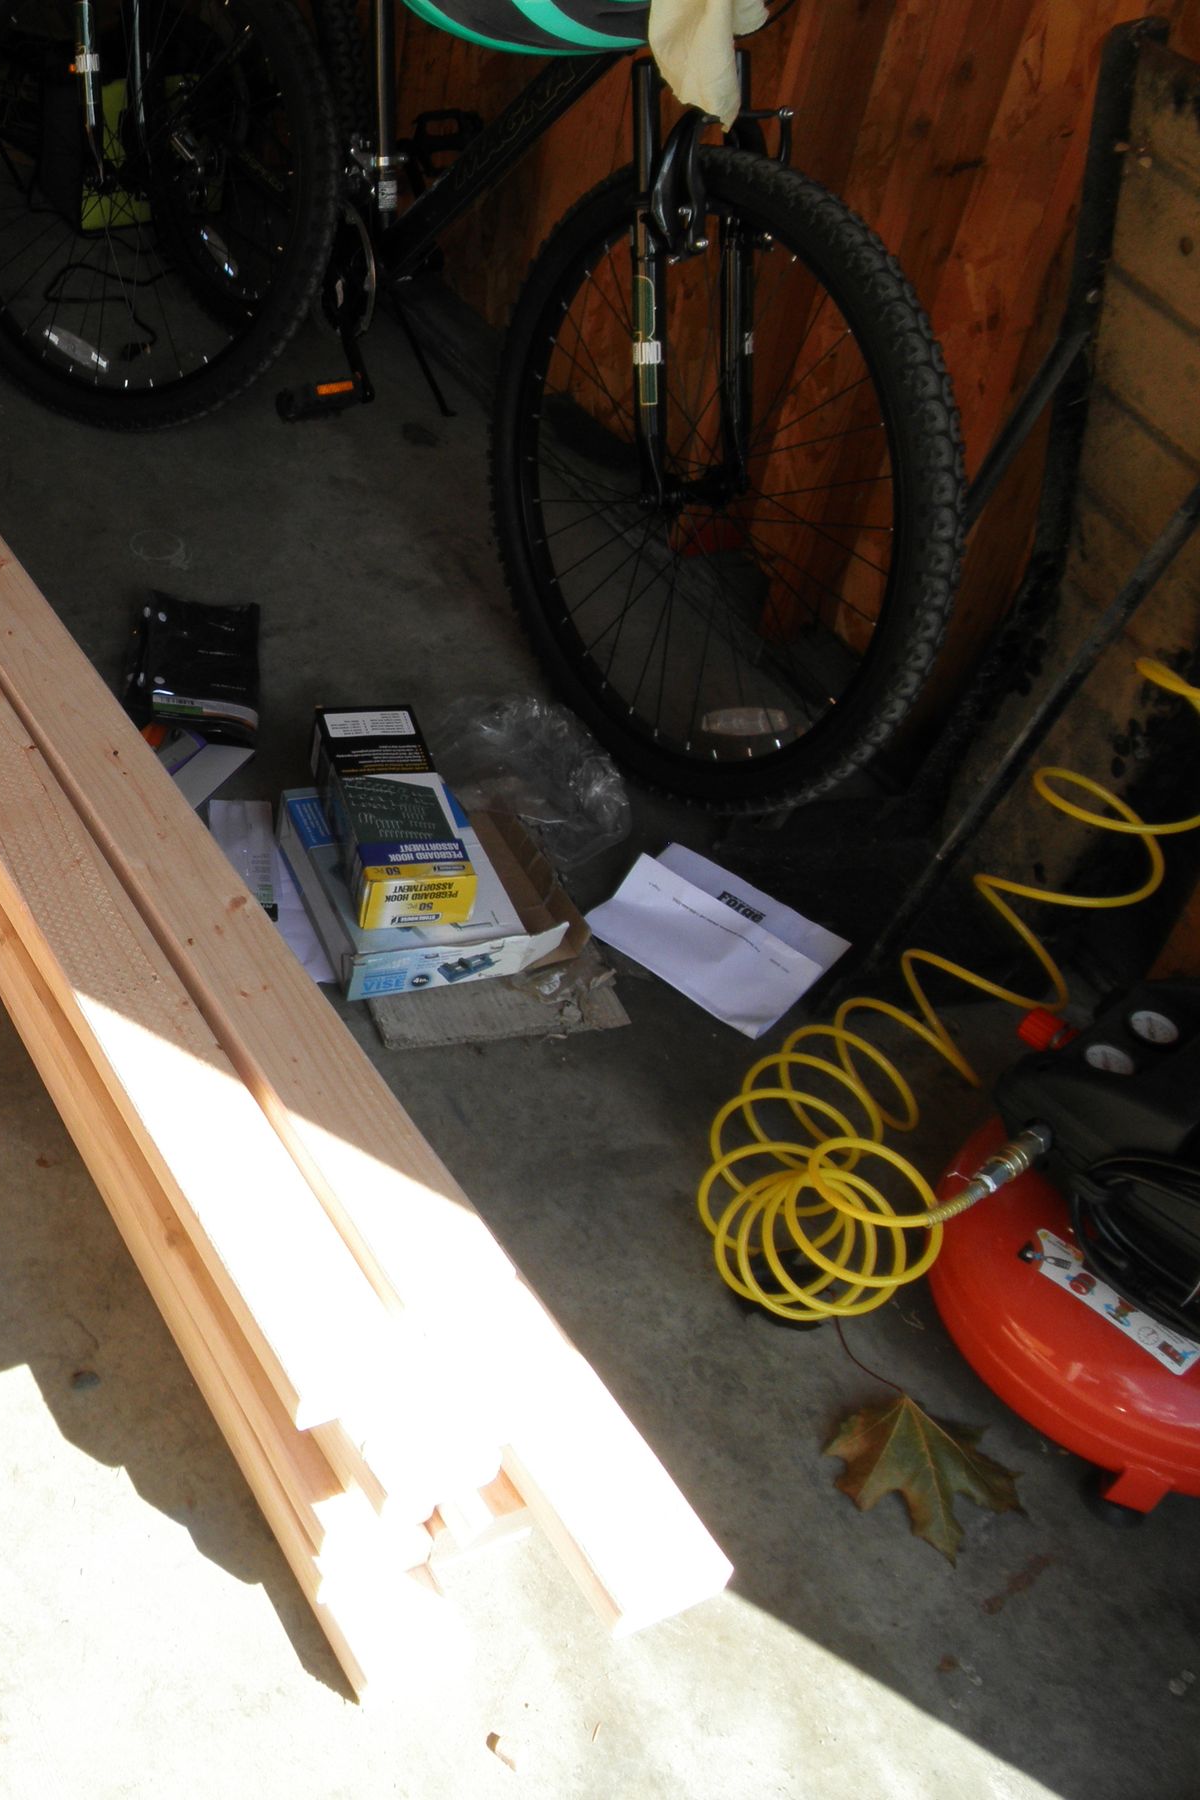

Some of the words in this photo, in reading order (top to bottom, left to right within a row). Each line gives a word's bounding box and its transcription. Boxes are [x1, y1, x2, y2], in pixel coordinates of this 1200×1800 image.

[399, 842, 460, 853] ASSORTMENT
[388, 853, 415, 862] HOOK
[415, 851, 464, 860] PEGBOARD
[385, 866, 401, 876] 50
[393, 882, 454, 894] ASSORTMENT
[384, 892, 410, 903] HOOK
[411, 890, 459, 901] PEGBOARD
[419, 902, 434, 911] 50
